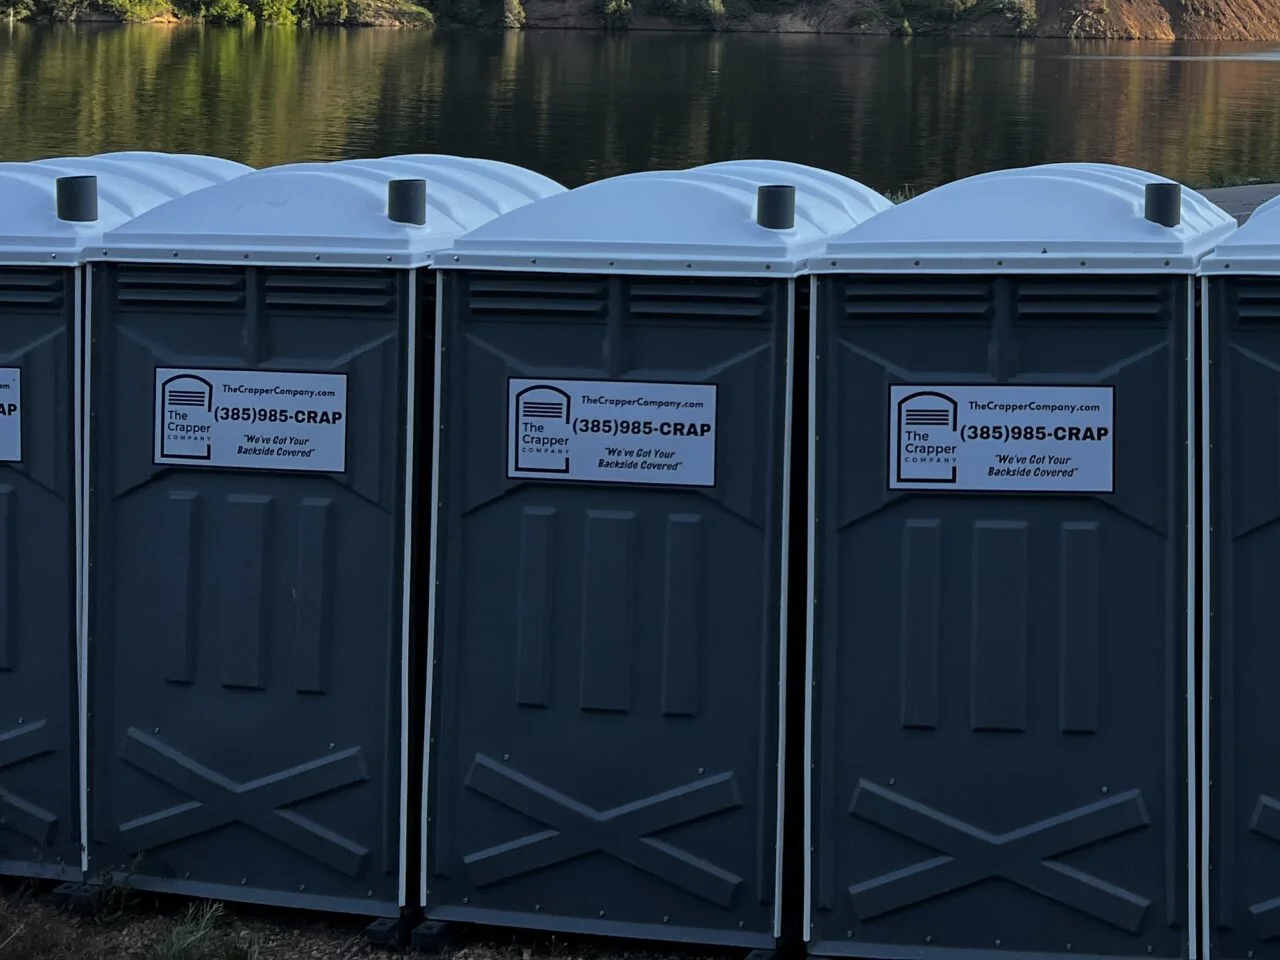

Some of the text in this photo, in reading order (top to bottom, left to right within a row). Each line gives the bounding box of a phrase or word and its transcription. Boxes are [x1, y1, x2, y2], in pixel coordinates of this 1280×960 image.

[222, 384, 335, 397] TheCrapperCompany.com
[581, 395, 704, 409] TheCrapperCompany.com
[969, 401, 1100, 413] TheCrapperCompany.com
[168, 410, 188, 420] The
[214, 406, 342, 424] (385)985-CRAP
[168, 422, 211, 433] Crapper
[522, 422, 544, 432] The
[572, 418, 711, 437] (385)985-CRAP
[905, 431, 929, 441] The
[960, 425, 1109, 442] (385)985-CRAP
[273, 435, 287, 444] Got
[288, 436, 309, 445] Your
[522, 434, 569, 446] Crapper
[237, 446, 316, 457] Backside Covered"
[636, 449, 652, 458] Got
[652, 449, 676, 459] Your
[905, 443, 957, 455] Crapper
[598, 459, 682, 471] Backside Covered"
[1029, 455, 1045, 465] Got
[1047, 456, 1071, 465] Your
[988, 467, 1078, 477] Backside Covered"
